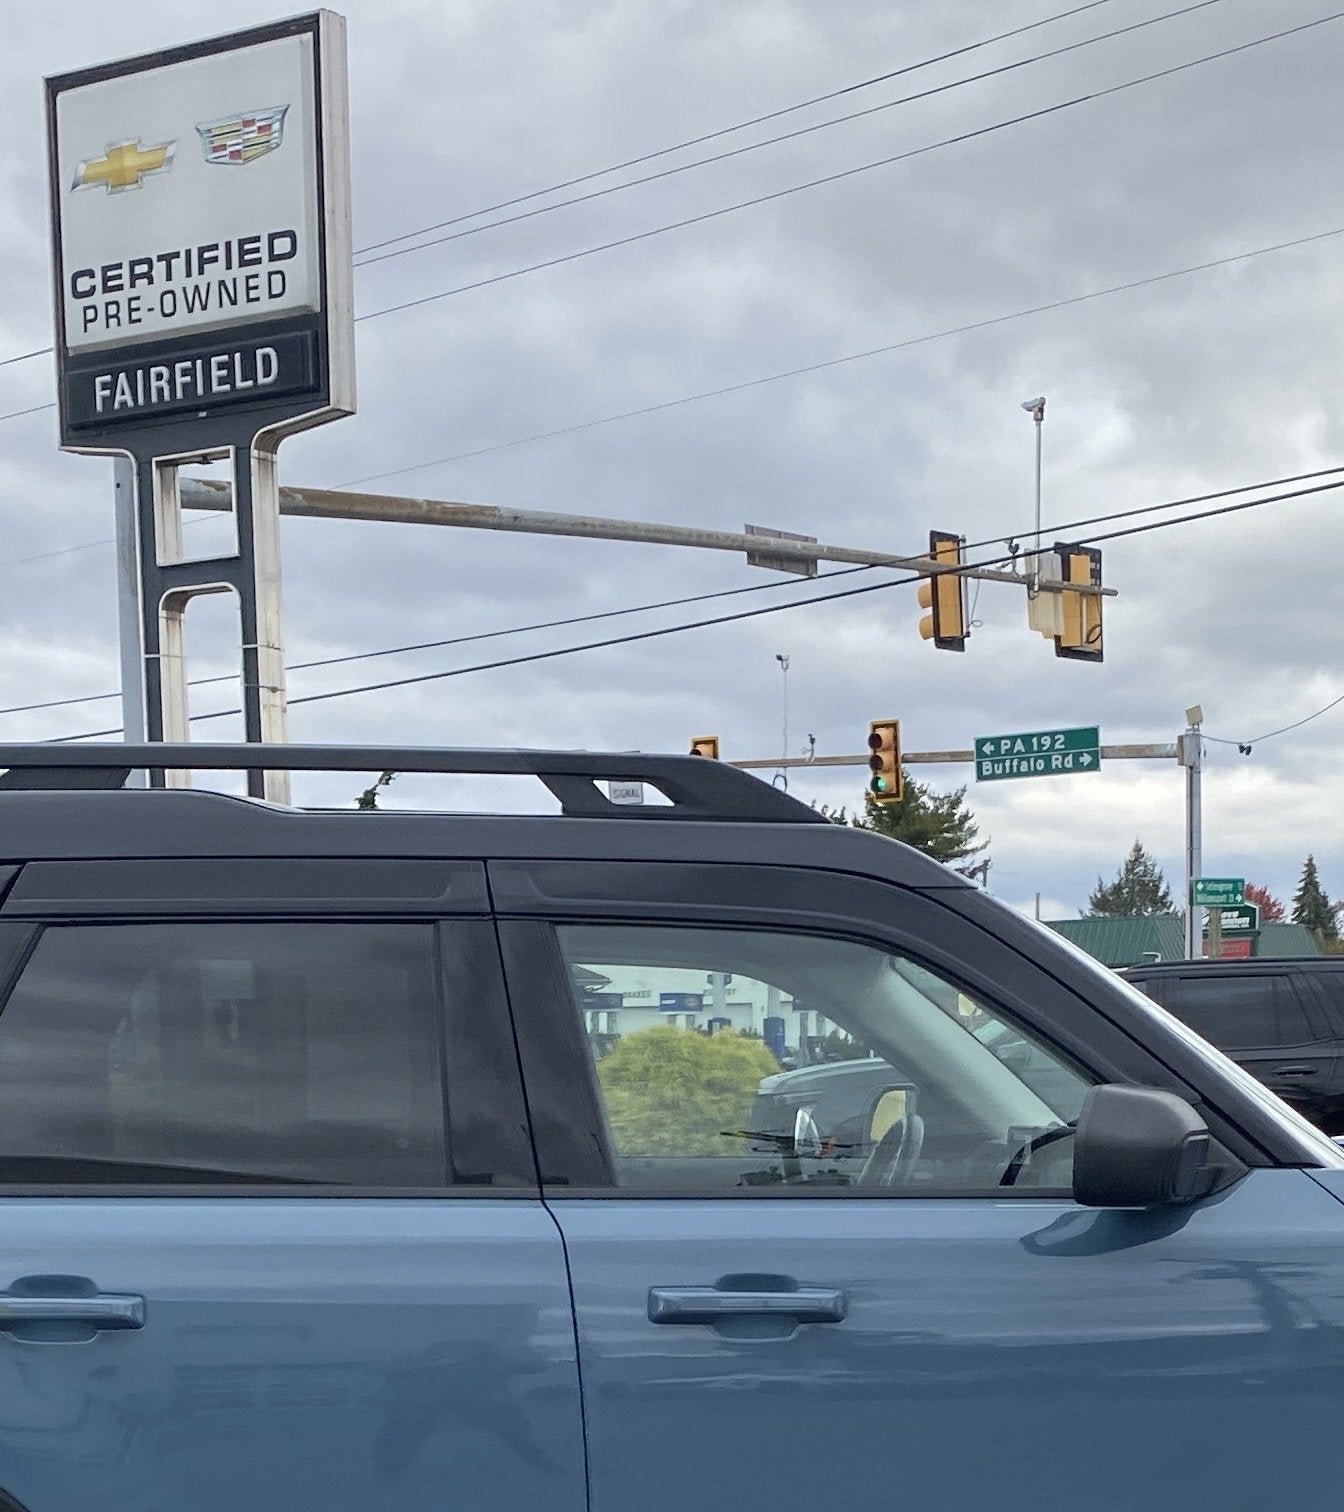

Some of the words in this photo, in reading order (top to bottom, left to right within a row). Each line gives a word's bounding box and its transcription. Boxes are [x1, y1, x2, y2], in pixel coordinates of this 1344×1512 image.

[71, 229, 298, 299] CERTIFIED
[82, 269, 287, 333] PRE-OWNED
[94, 346, 279, 413] FAIRFIELD
[982, 757, 1045, 776] Buffalo
[1051, 753, 1074, 770] Rd
[1000, 738, 1026, 755] PA
[1031, 734, 1066, 751] 192
